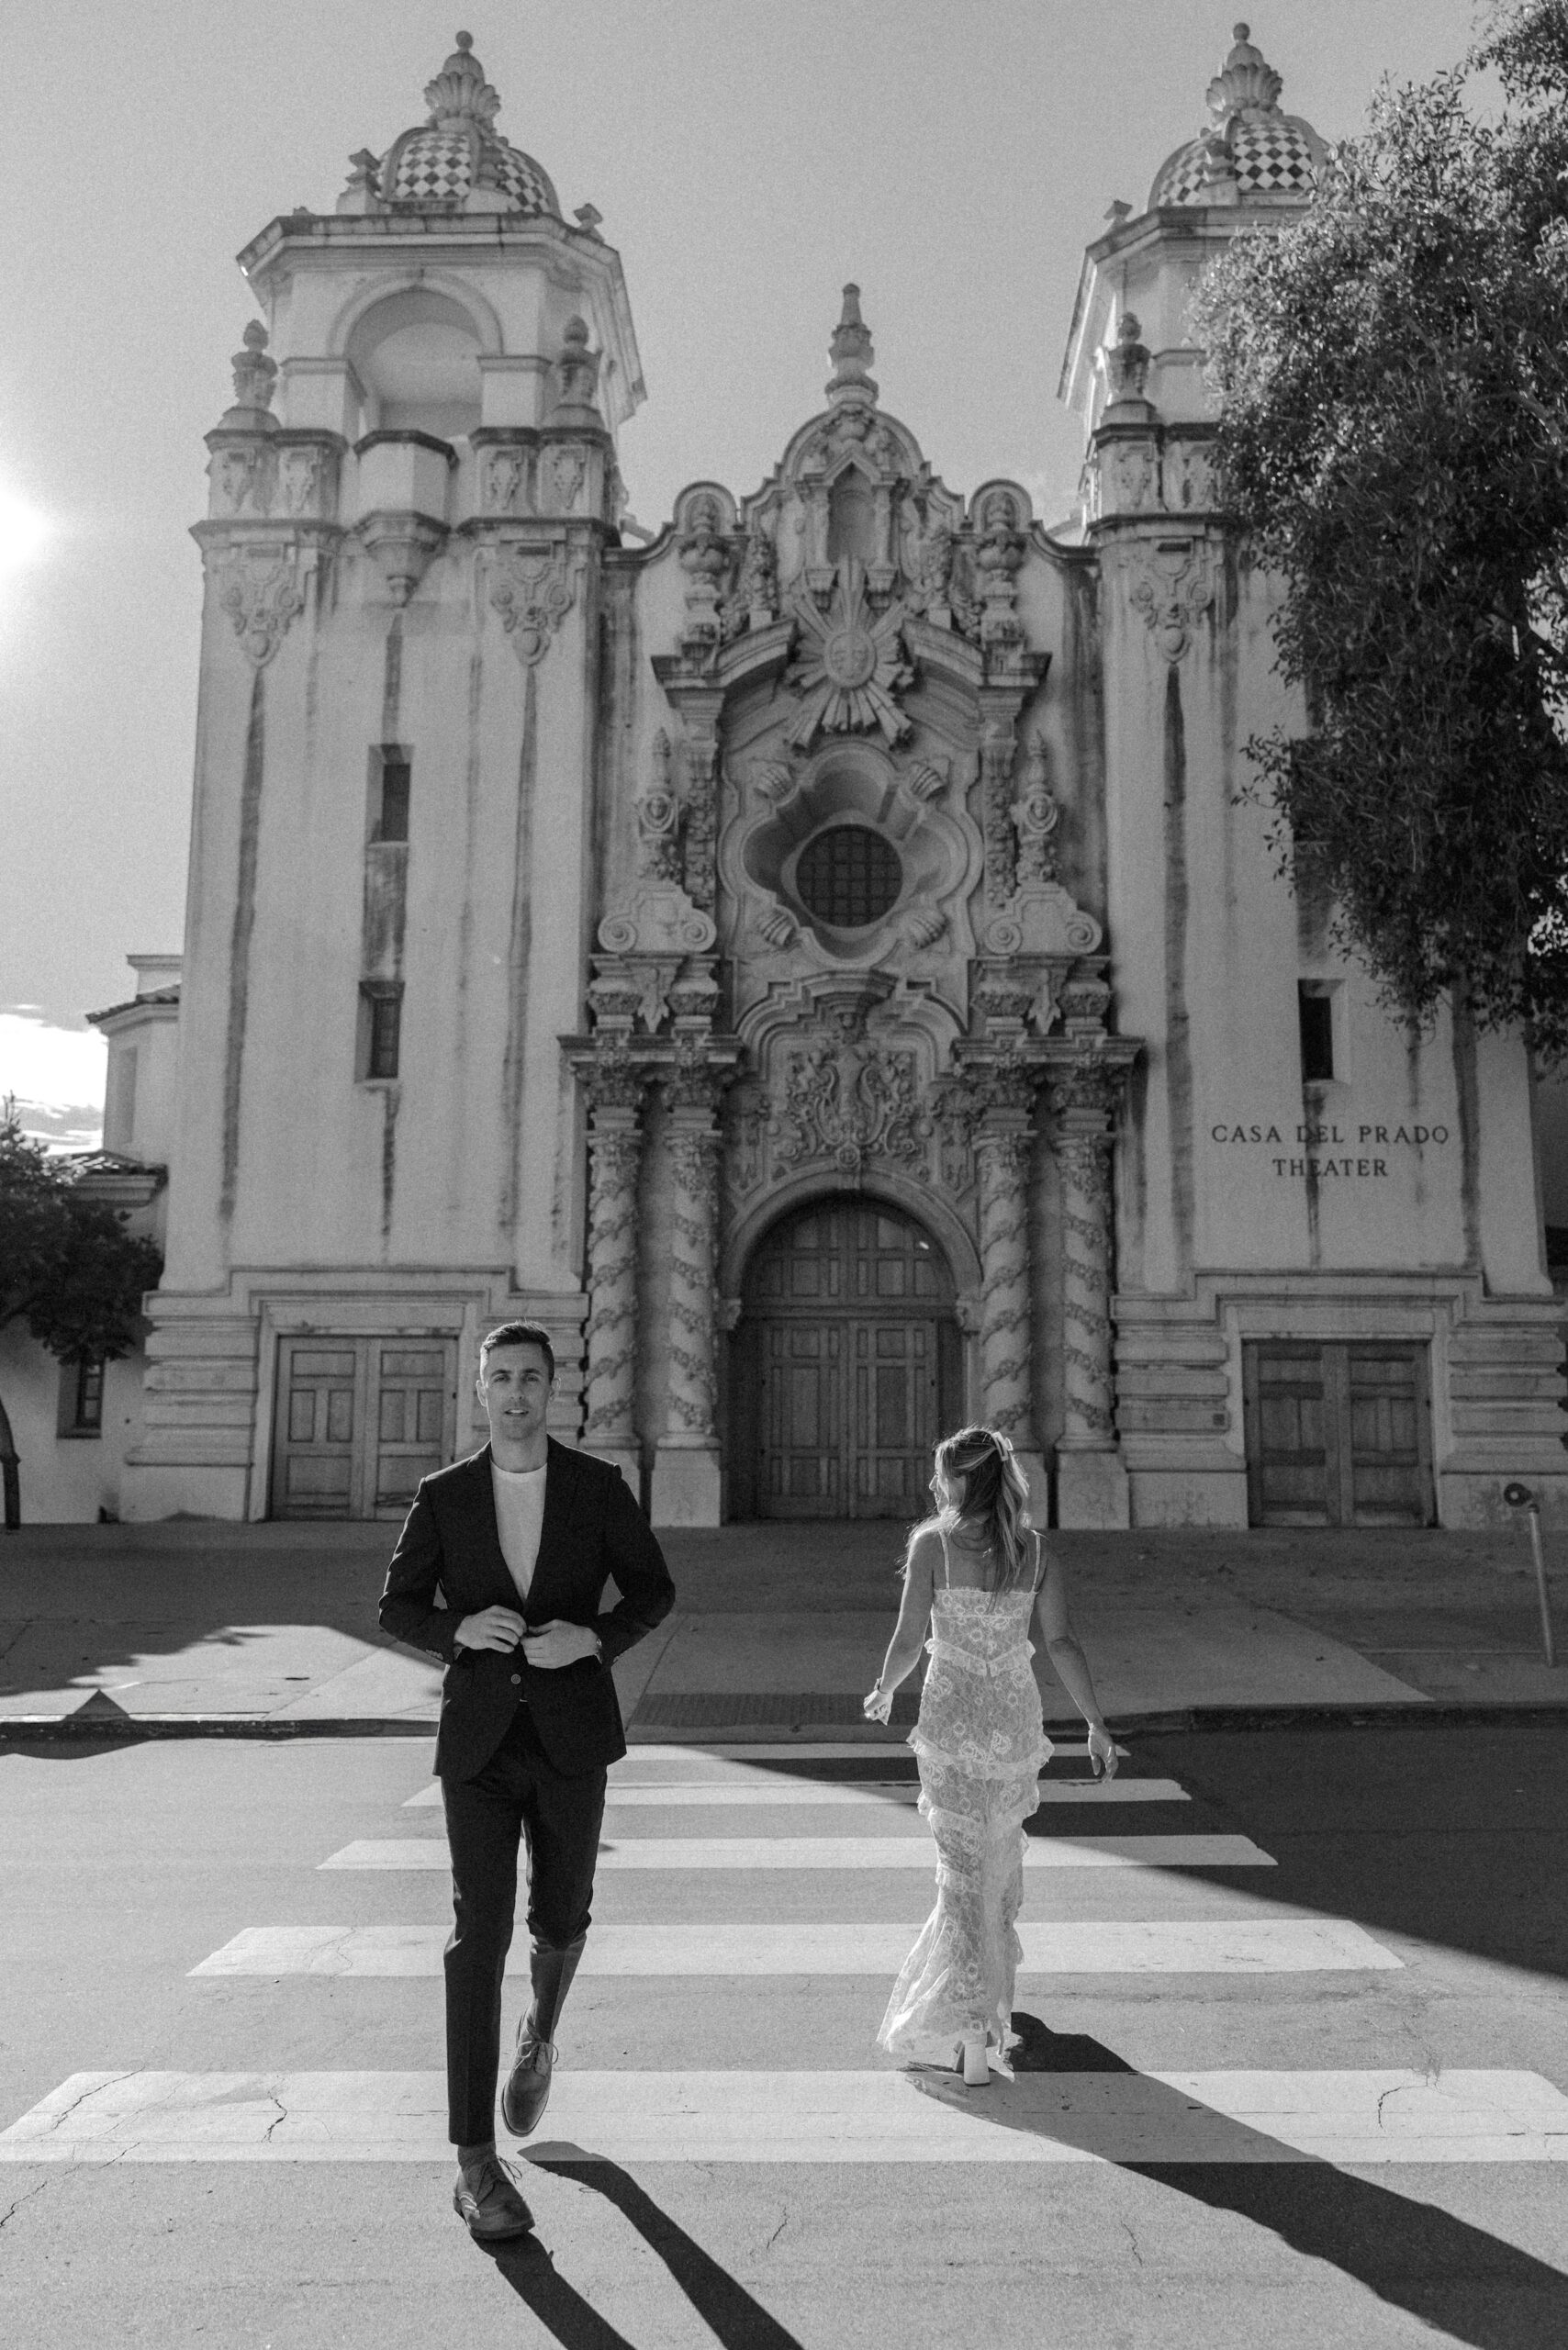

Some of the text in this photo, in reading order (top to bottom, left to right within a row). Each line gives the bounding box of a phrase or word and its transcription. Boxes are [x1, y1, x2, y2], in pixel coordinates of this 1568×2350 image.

[1211, 1125, 1449, 1145] CASA DEL PRADO
[1272, 1158, 1388, 1177] THEATER
